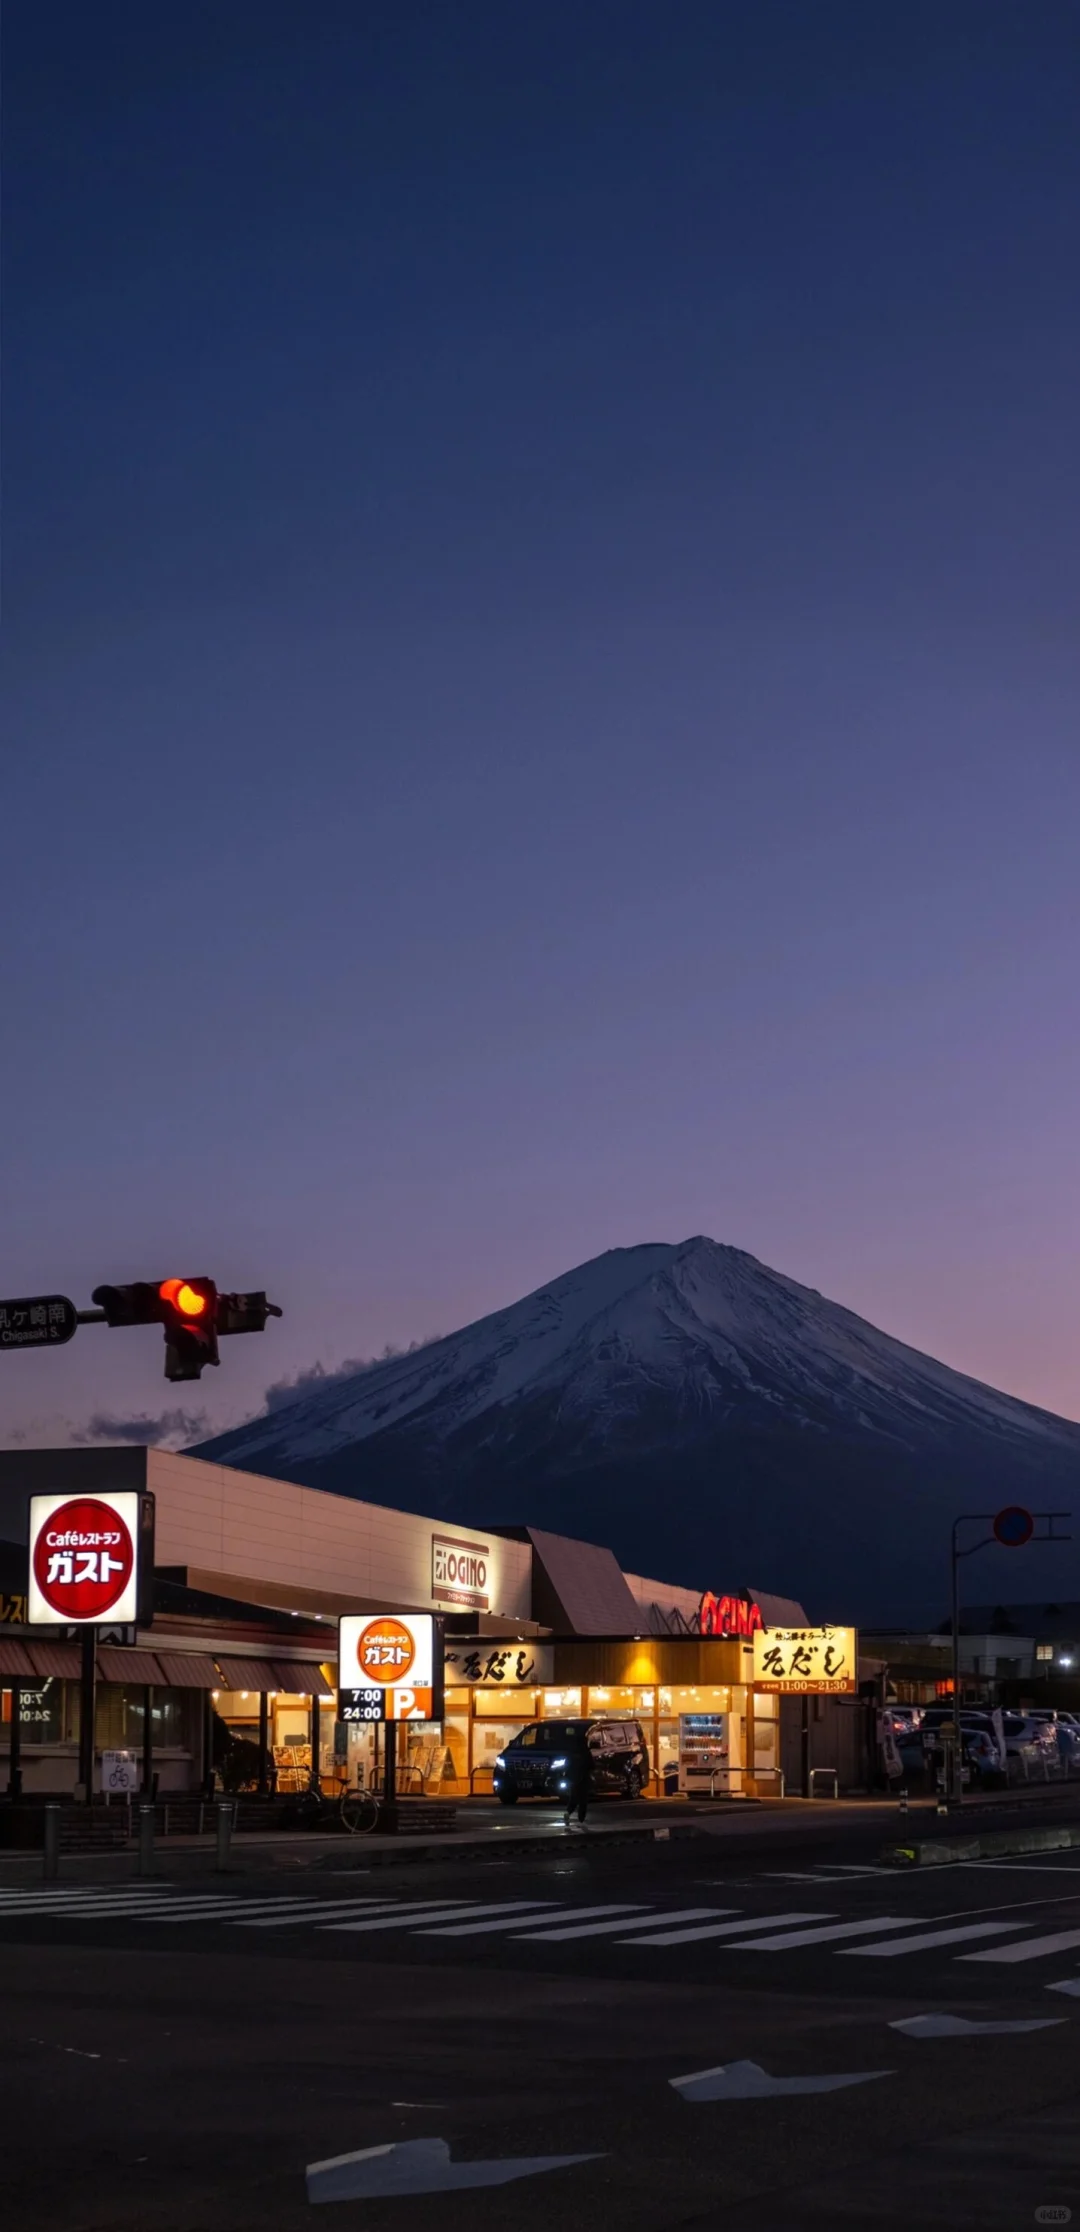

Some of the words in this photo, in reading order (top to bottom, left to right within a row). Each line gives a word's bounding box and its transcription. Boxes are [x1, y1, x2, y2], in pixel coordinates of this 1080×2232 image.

[2, 1329, 47, 1342] Chigasaki
[50, 1326, 60, 1337] S.
[46, 1550, 124, 1584] ガスト
[447, 1553, 487, 1588] OGINO
[364, 1646, 410, 1665] ガスト
[463, 1651, 534, 1682] そだし
[762, 1646, 844, 1677] そだし
[351, 1690, 381, 1702] 7:00
[394, 1689, 415, 1719] P
[343, 1707, 381, 1719] 24:00
